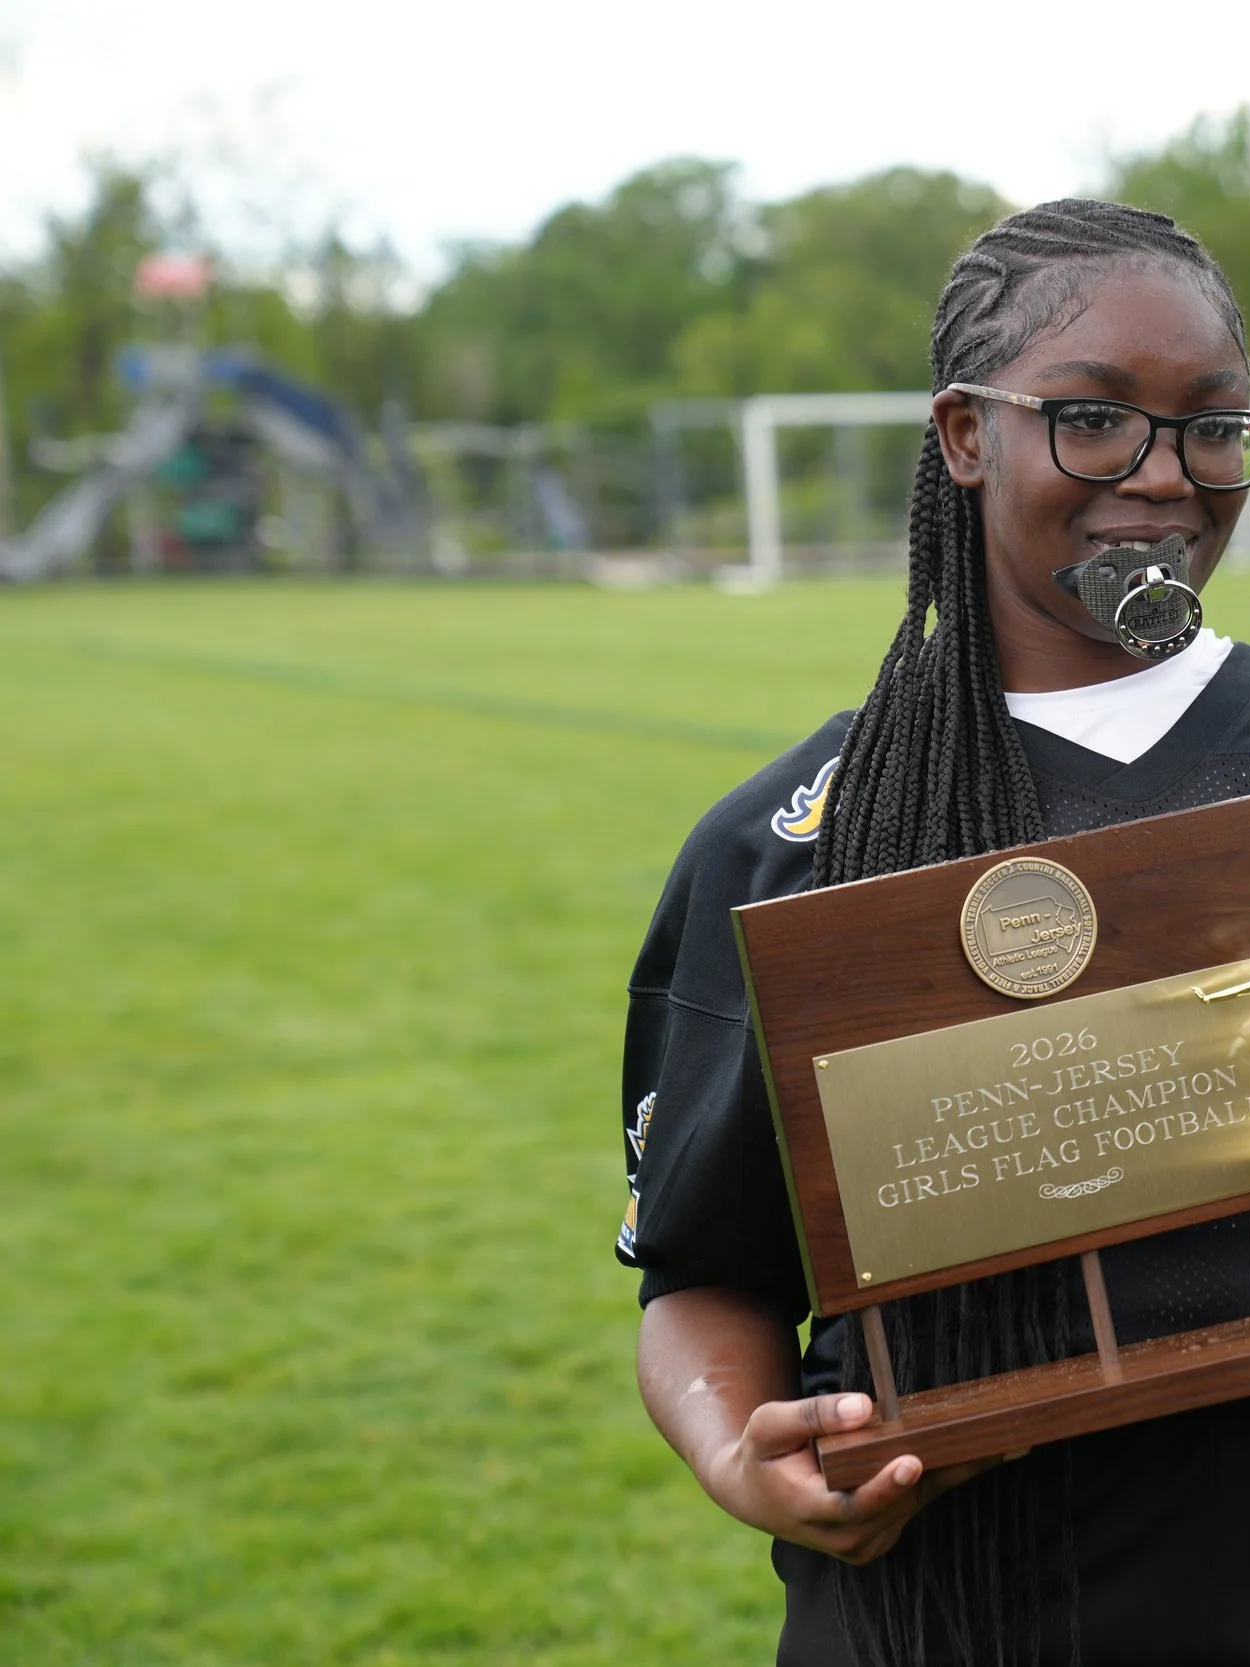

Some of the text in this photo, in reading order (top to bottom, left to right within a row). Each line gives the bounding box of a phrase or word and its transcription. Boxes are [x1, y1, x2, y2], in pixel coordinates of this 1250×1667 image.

[979, 868, 1009, 894] SOCCER
[1009, 862, 1056, 875] X-COUNTRY
[966, 892, 983, 922] TENNIS
[1054, 869, 1091, 914] BASKETBALL
[999, 912, 1041, 932] Penn
[1031, 922, 1082, 943] Jersey
[1079, 914, 1093, 956] SOFTBALL
[966, 925, 989, 974] VOLLEYBALL
[992, 945, 1058, 968] Athletic League
[989, 972, 1012, 990] FIELD
[1049, 956, 1084, 988] BASEBALL
[1021, 983, 1050, 993] TRACK
[1010, 1027, 1098, 1068] 2026
[930, 1040, 1185, 1123] PENN-JERSEY
[892, 1065, 1237, 1169] LEAGUE CHAMPION
[877, 1163, 980, 1208] GIRLS
[991, 1139, 1082, 1182] FLAG
